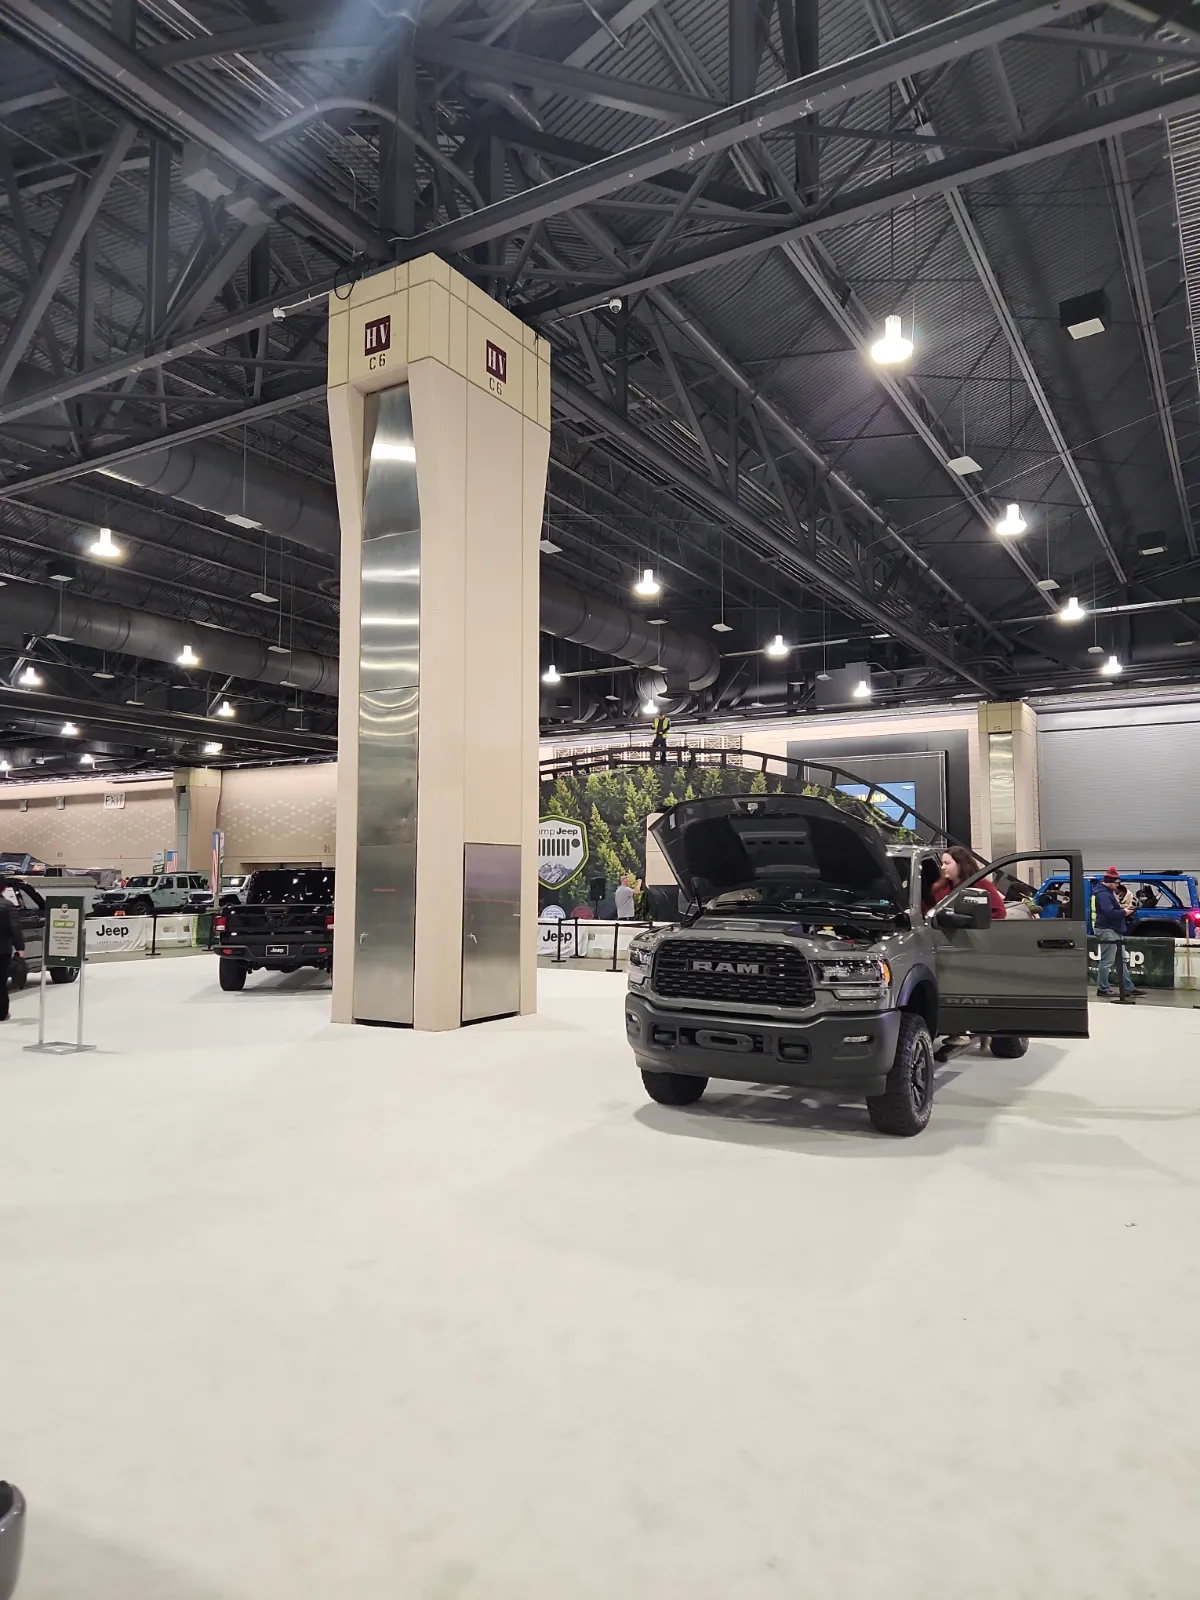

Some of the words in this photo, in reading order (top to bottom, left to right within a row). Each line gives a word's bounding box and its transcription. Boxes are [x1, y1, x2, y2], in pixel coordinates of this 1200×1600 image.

[366, 322, 390, 350] HV
[488, 347, 506, 375] HV
[106, 794, 123, 806] EXIT
[556, 828, 578, 836] Jeep
[96, 925, 129, 937] Jeep
[543, 930, 572, 944] Jeep
[693, 961, 759, 974] RAM
